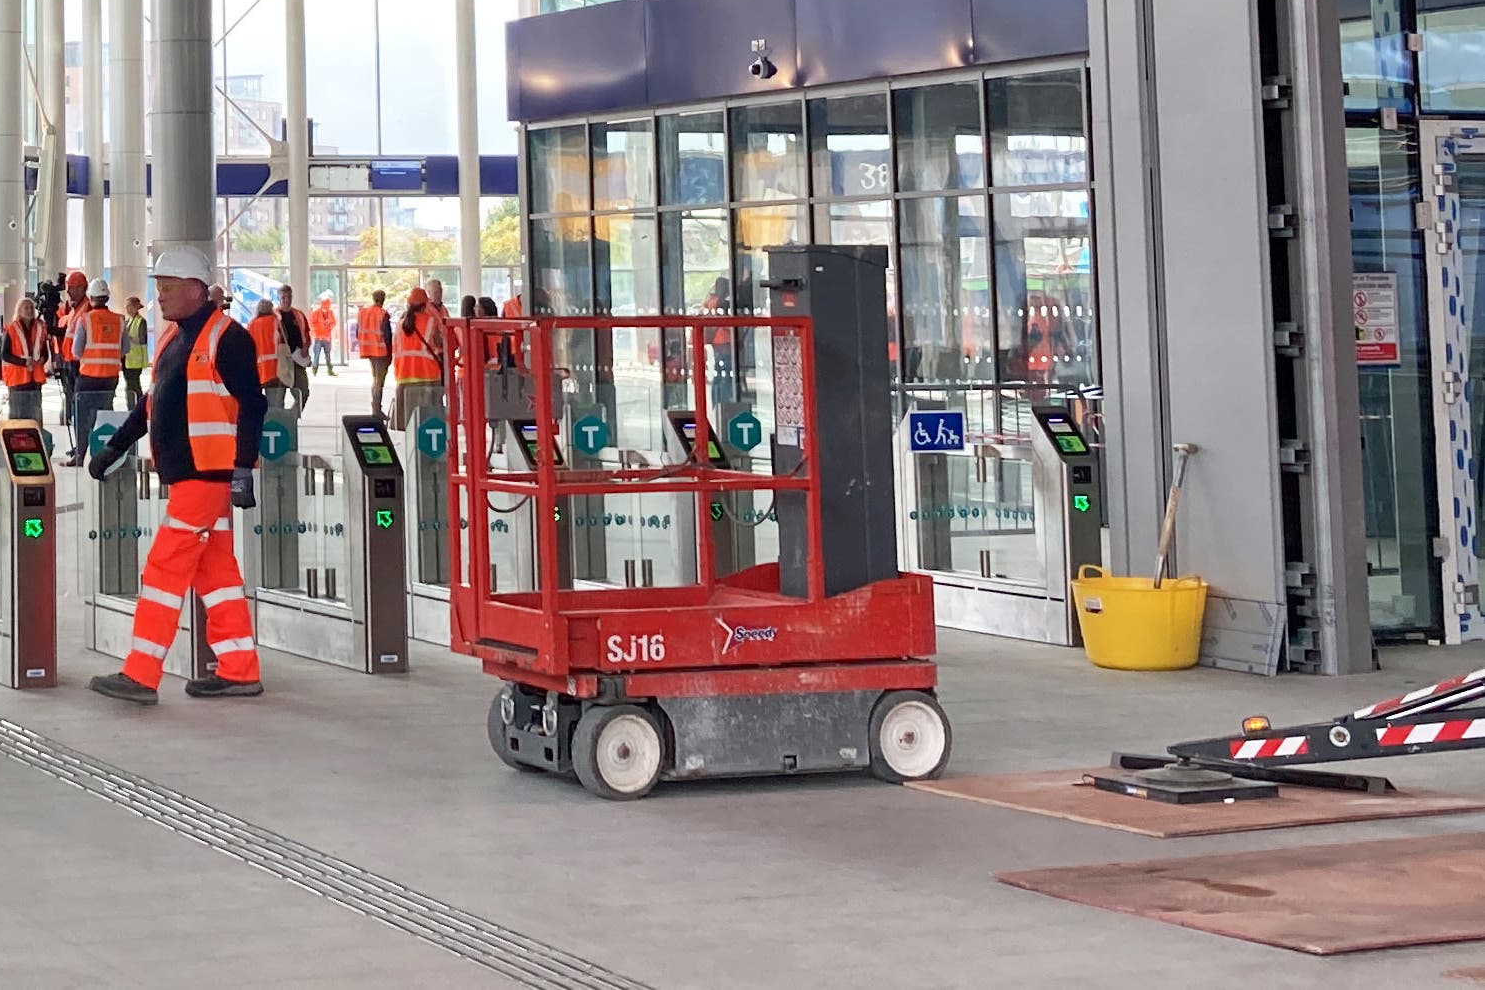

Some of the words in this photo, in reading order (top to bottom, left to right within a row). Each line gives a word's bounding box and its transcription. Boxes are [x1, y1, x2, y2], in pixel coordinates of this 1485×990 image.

[425, 428, 443, 451] T
[581, 425, 599, 448] T
[736, 422, 754, 445] T
[607, 634, 665, 663] SJ16
